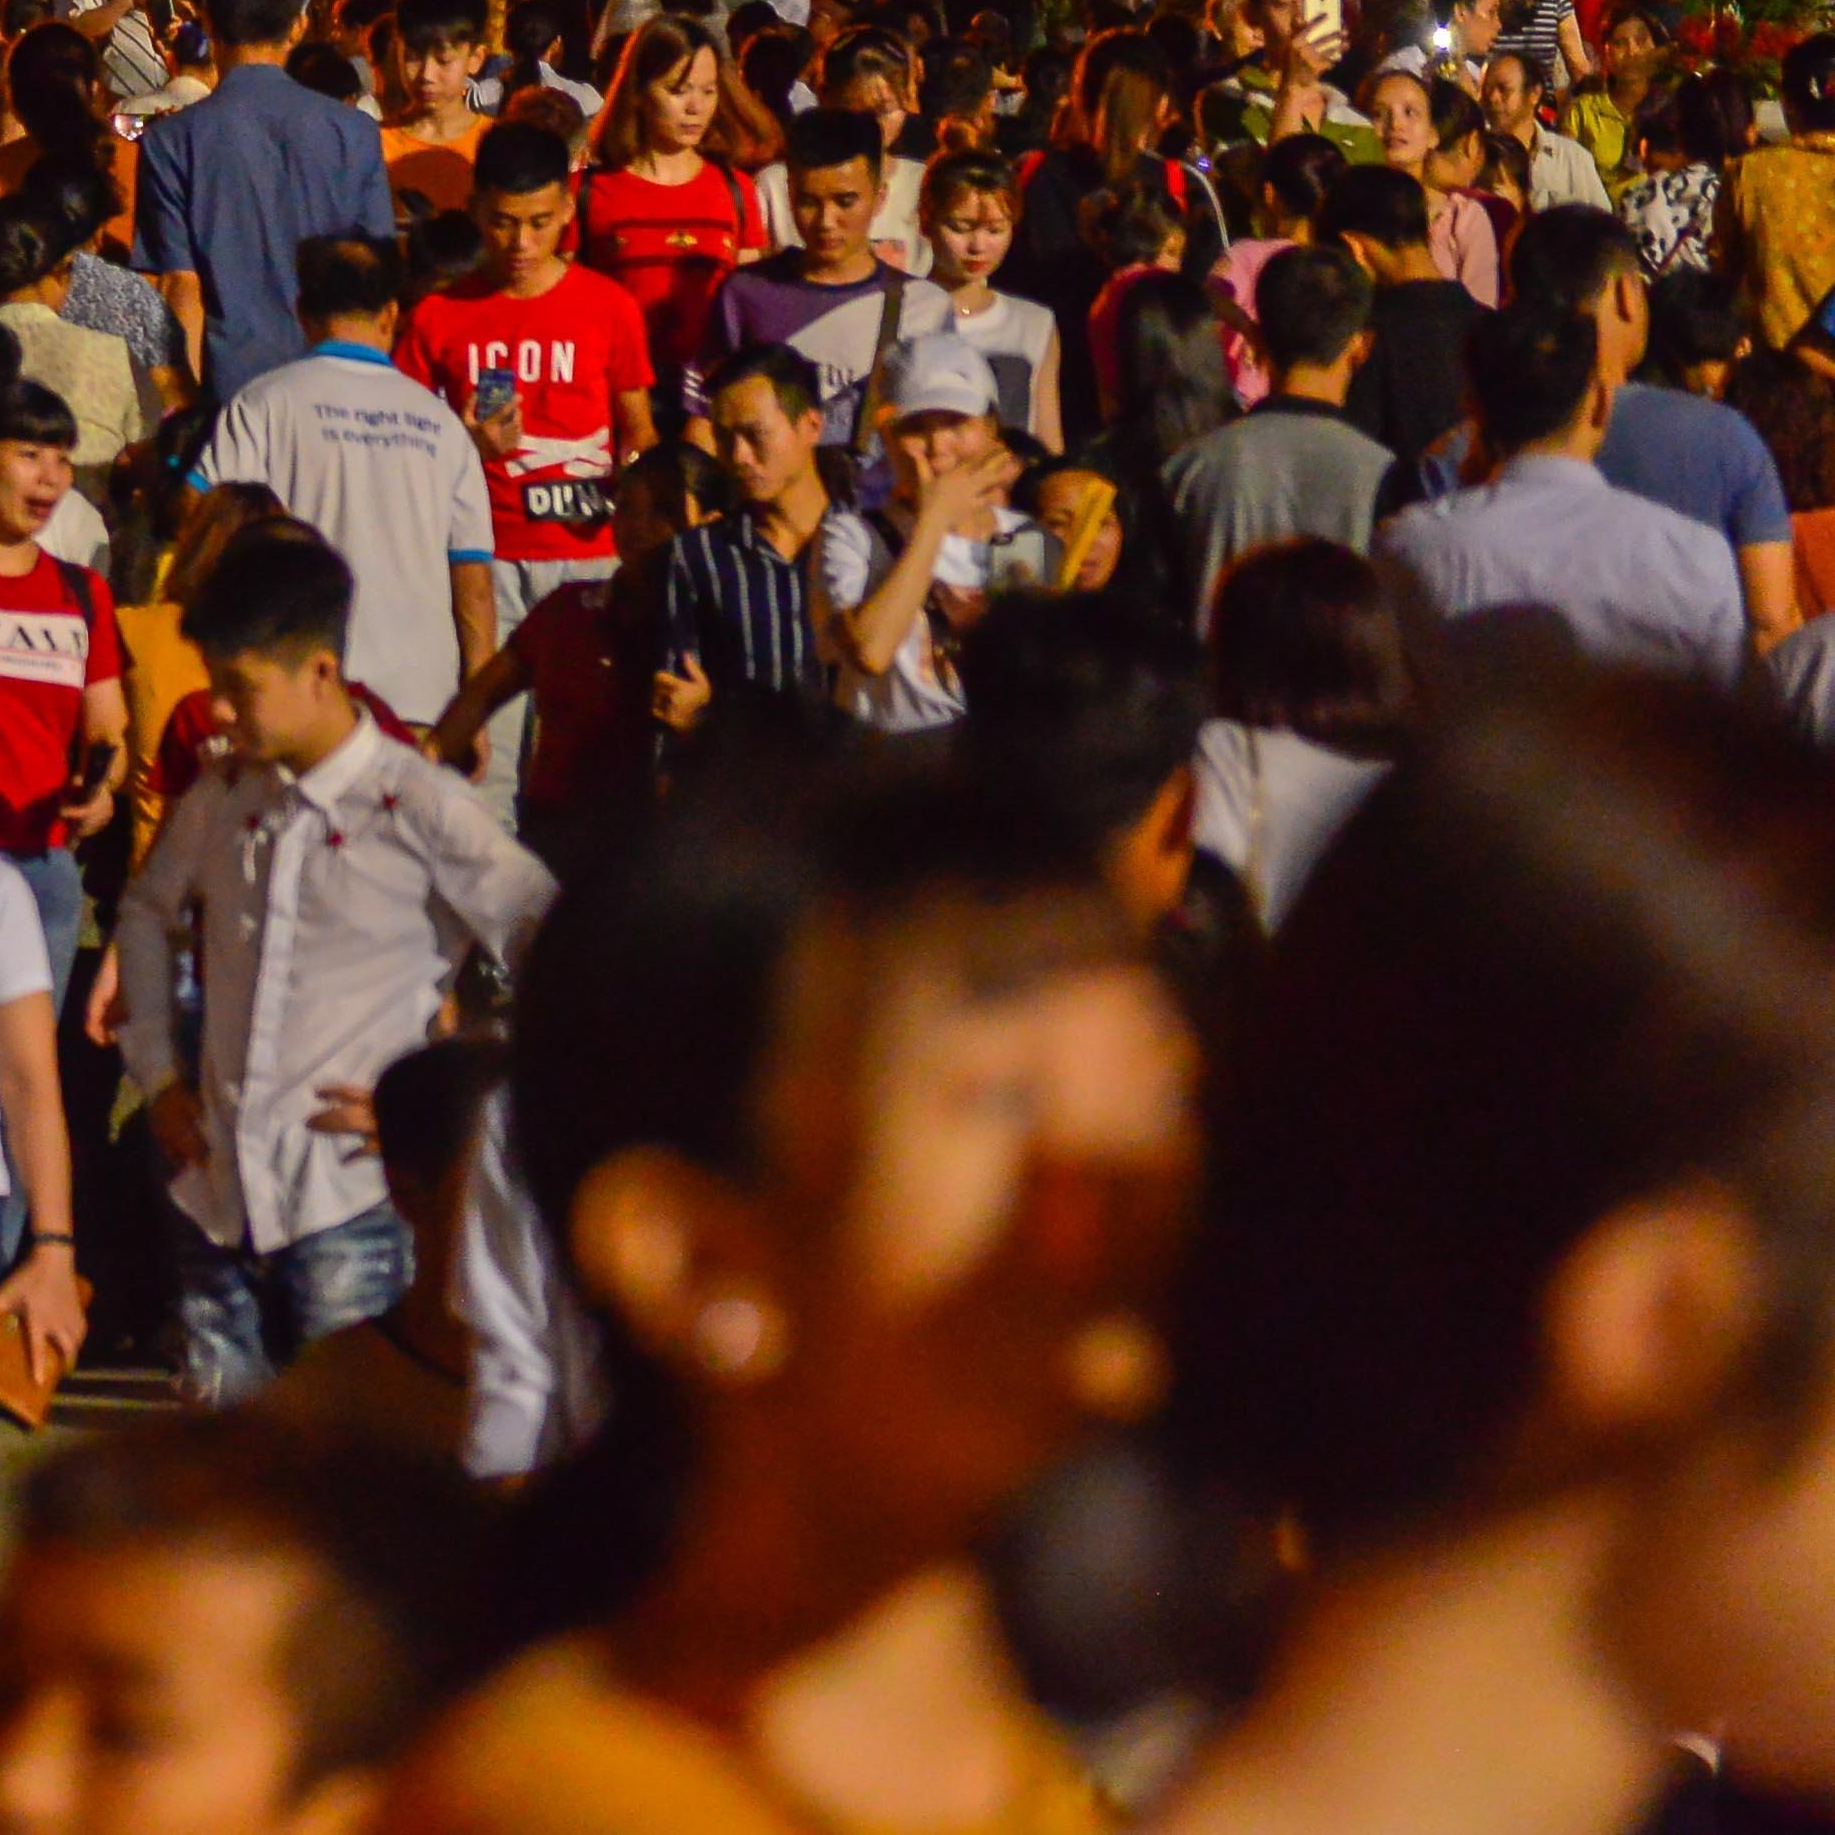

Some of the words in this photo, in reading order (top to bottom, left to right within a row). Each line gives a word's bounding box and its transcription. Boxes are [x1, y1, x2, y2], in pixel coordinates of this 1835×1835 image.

[468, 338, 575, 385] ICON
[353, 408, 398, 427] right
[321, 427, 339, 440] is
[342, 429, 436, 458] everything
